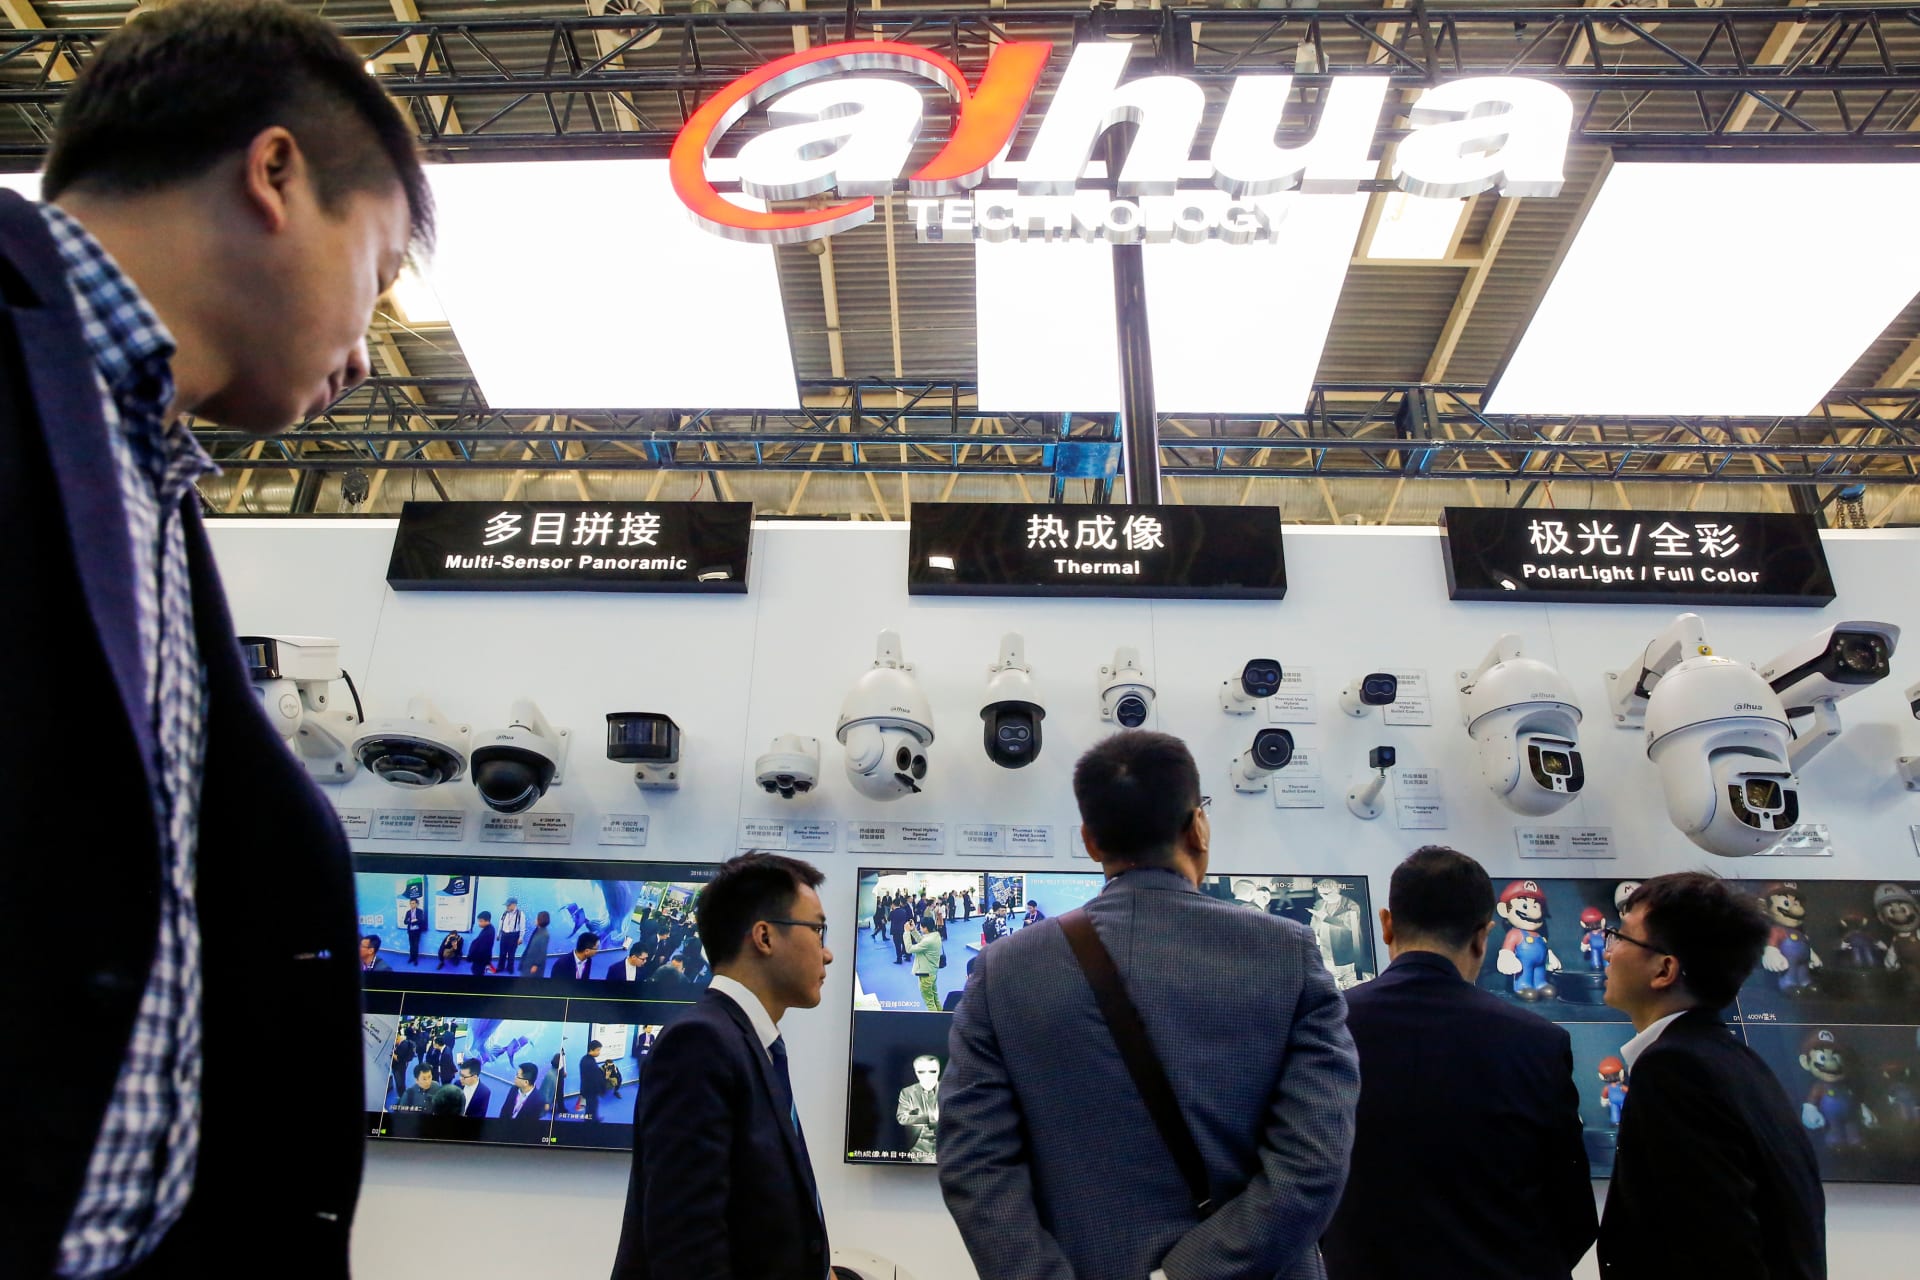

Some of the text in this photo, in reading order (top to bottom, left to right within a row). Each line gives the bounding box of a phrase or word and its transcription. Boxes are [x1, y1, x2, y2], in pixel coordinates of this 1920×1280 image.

[906, 199, 1290, 243] TECHNOLOGY
[482, 511, 661, 547] 多目拼接
[1026, 514, 1165, 550] 热成像
[1527, 519, 1740, 558] 极光/全彩
[445, 554, 687, 571] Multi-Sensor Panoramic
[1054, 559, 1140, 575] Thermal
[1522, 564, 1633, 583] PolarLight
[1654, 566, 1694, 582] Full
[1700, 567, 1760, 583] Color
